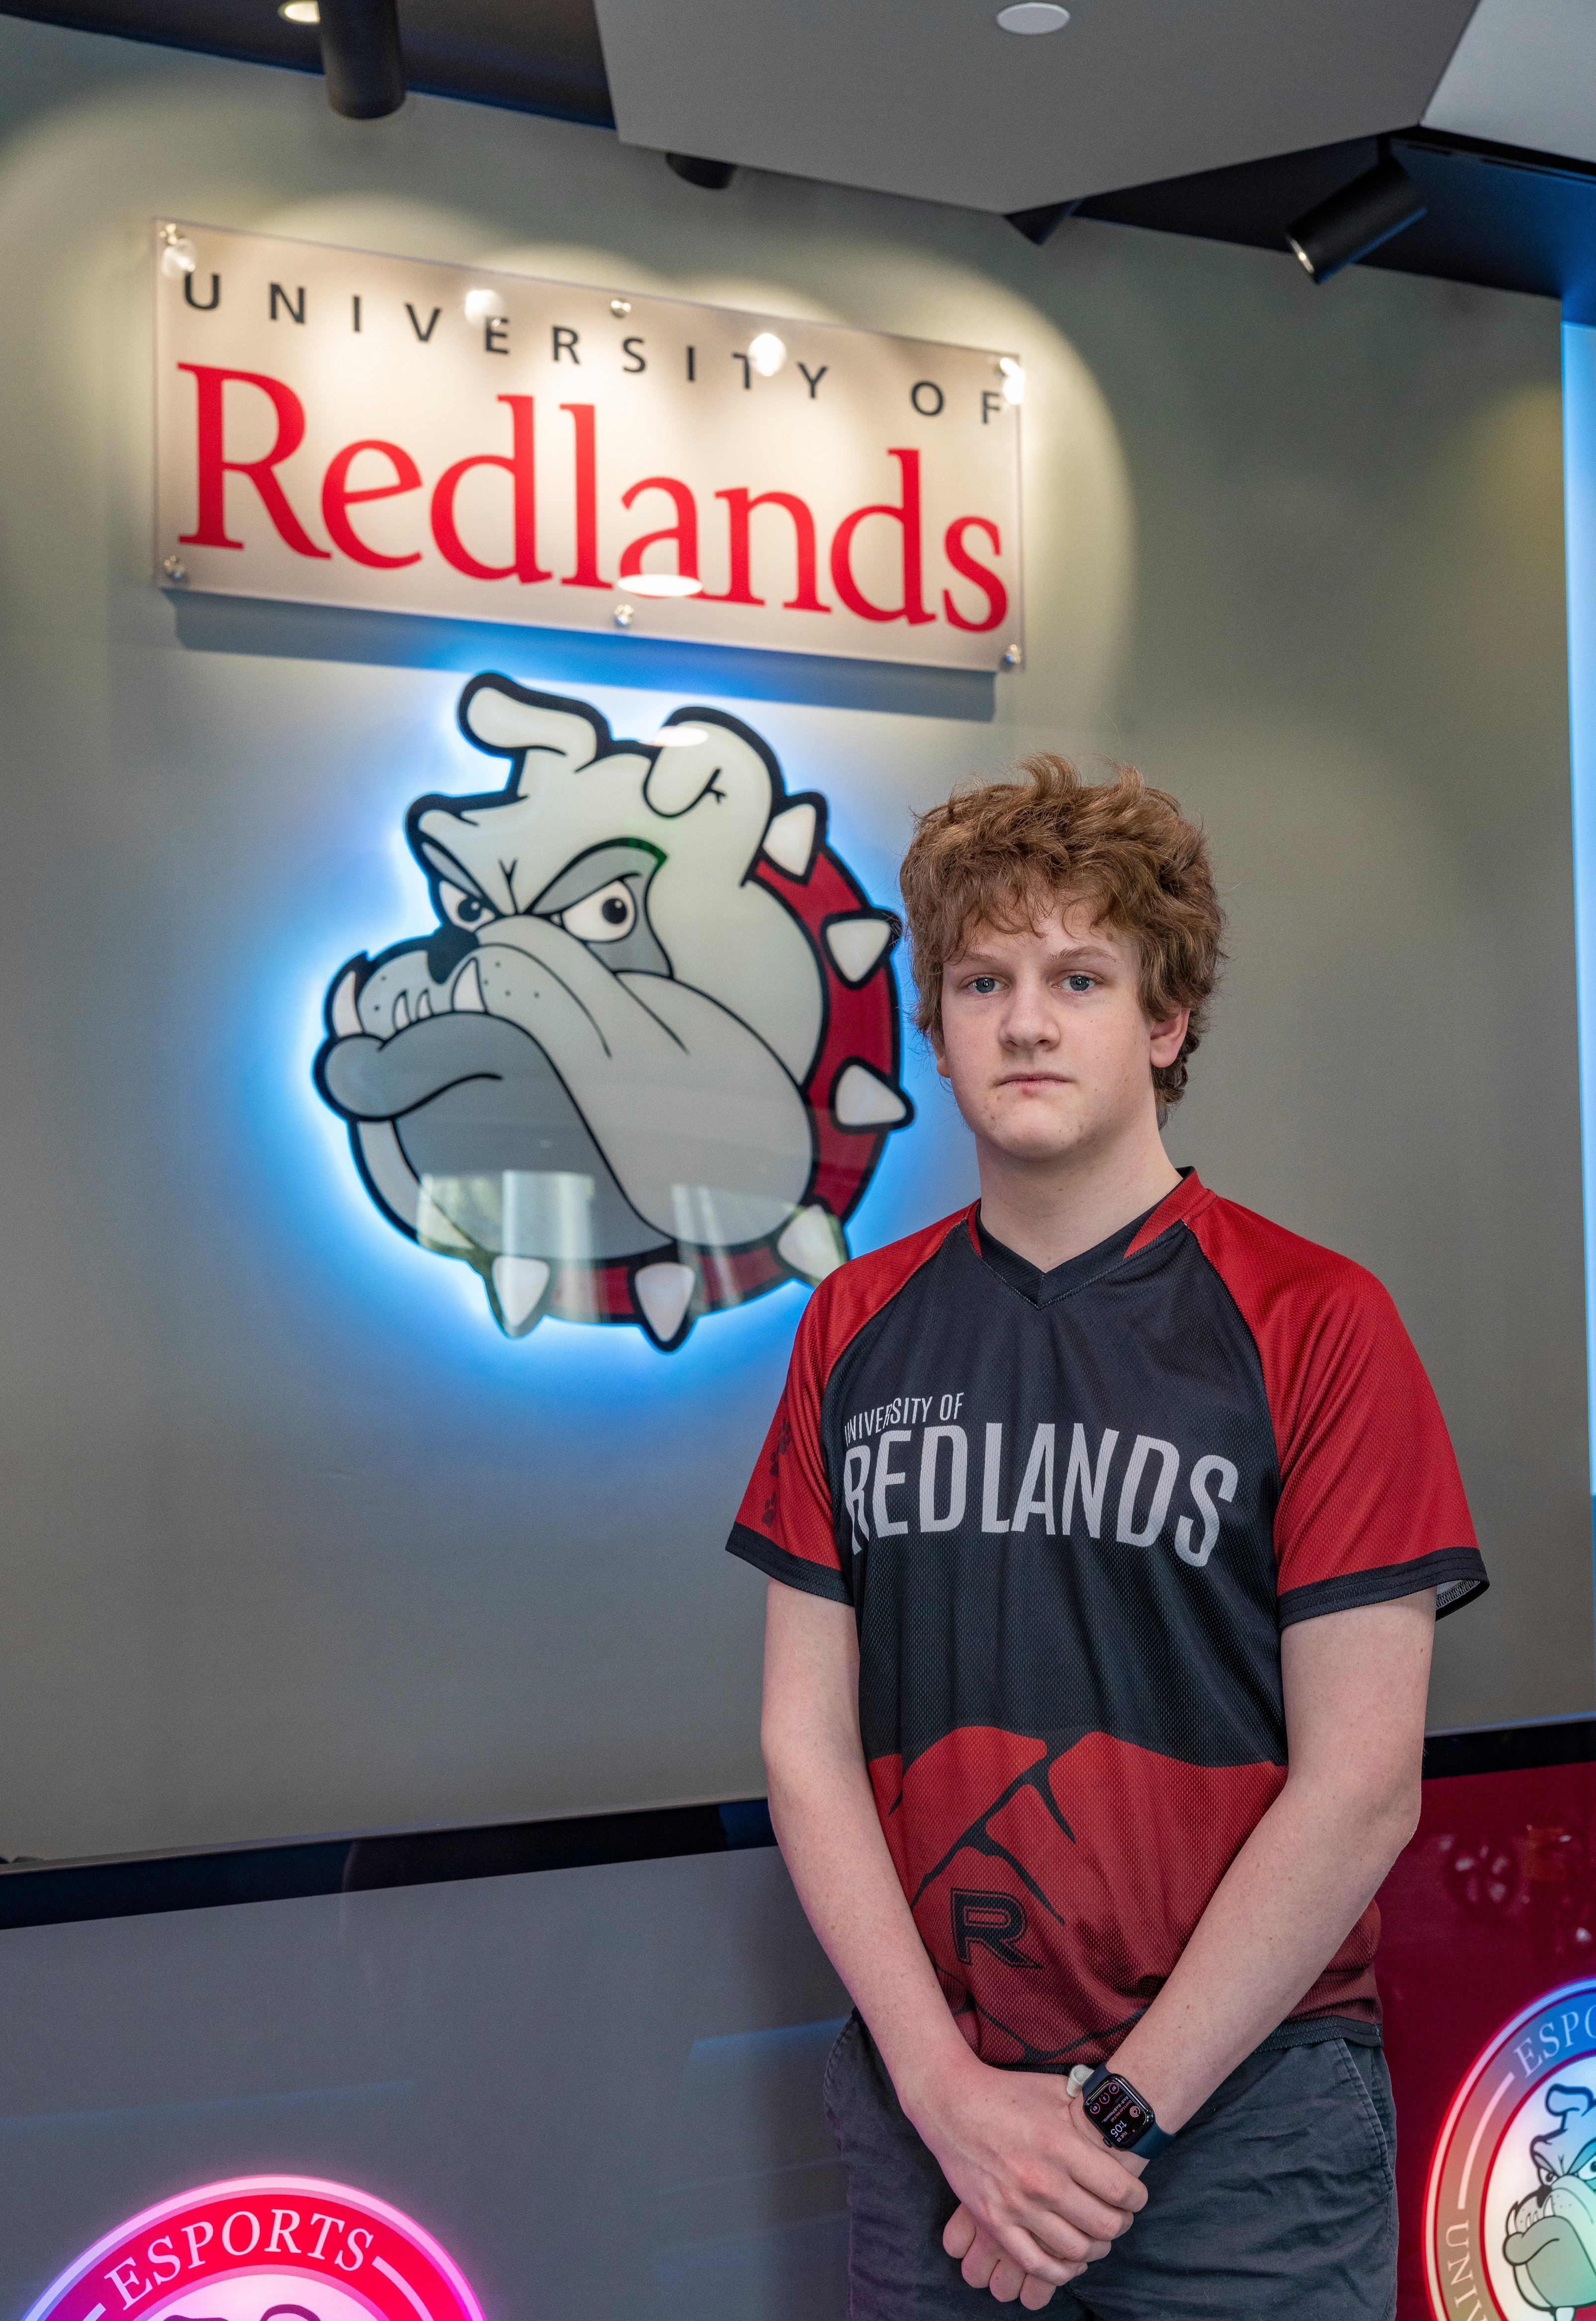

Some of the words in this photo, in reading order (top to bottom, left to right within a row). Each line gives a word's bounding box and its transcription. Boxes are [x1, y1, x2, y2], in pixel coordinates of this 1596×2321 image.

[184, 271, 828, 400] UNIVERSITY
[911, 380, 1001, 424] OF
[176, 361, 1008, 634] Redlands
[939, 1392, 964, 1421] OF
[843, 1422, 1239, 1568] REDLANDS
[950, 1887, 1043, 1970] R
[1110, 2120, 1127, 2137] 1:05
[104, 2209, 374, 2311] ESPORTS
